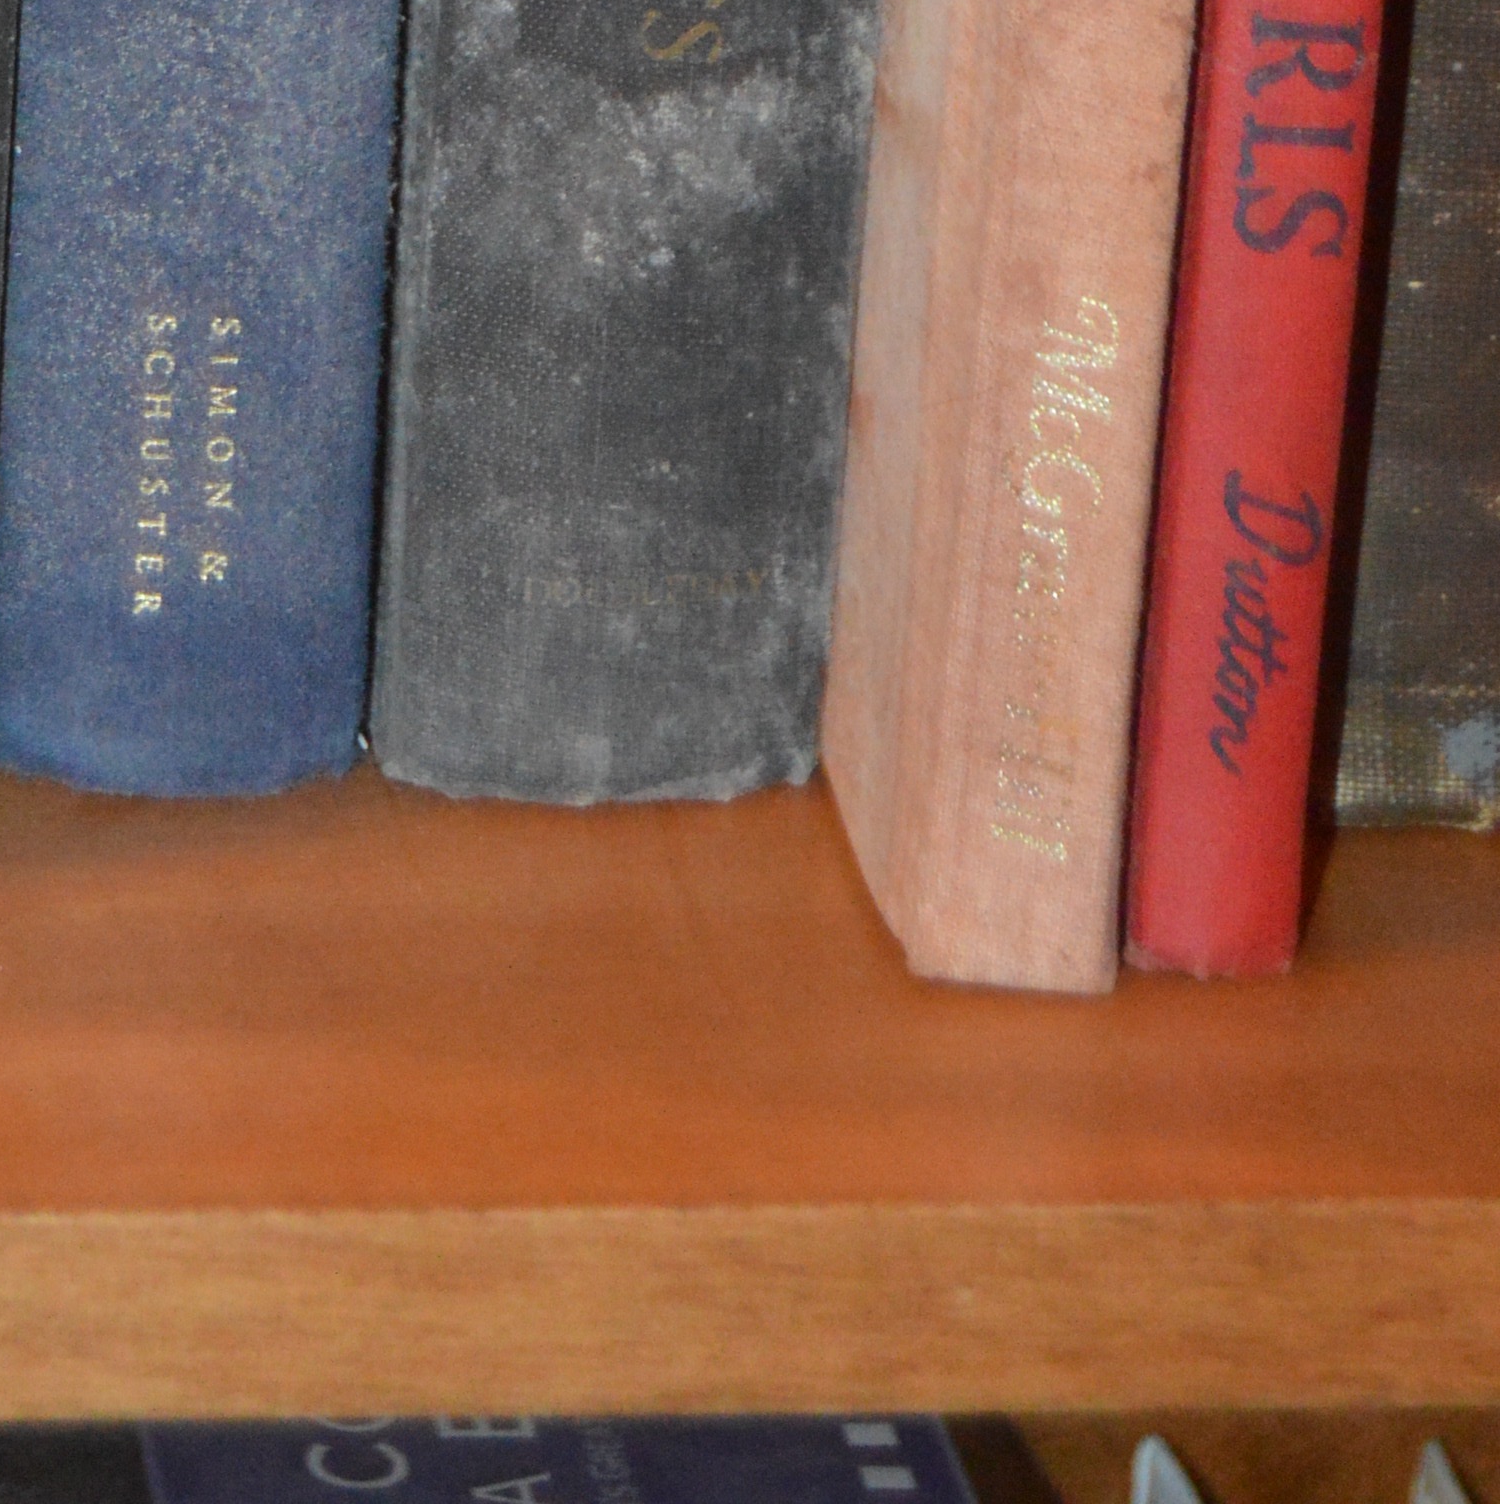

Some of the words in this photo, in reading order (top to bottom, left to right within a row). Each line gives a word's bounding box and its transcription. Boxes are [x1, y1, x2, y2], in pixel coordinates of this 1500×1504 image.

[132, 312, 178, 616] SCHUSTER
[206, 316, 242, 513] SIMON
[200, 549, 229, 582] &
[1210, 468, 1323, 778] Dutton
